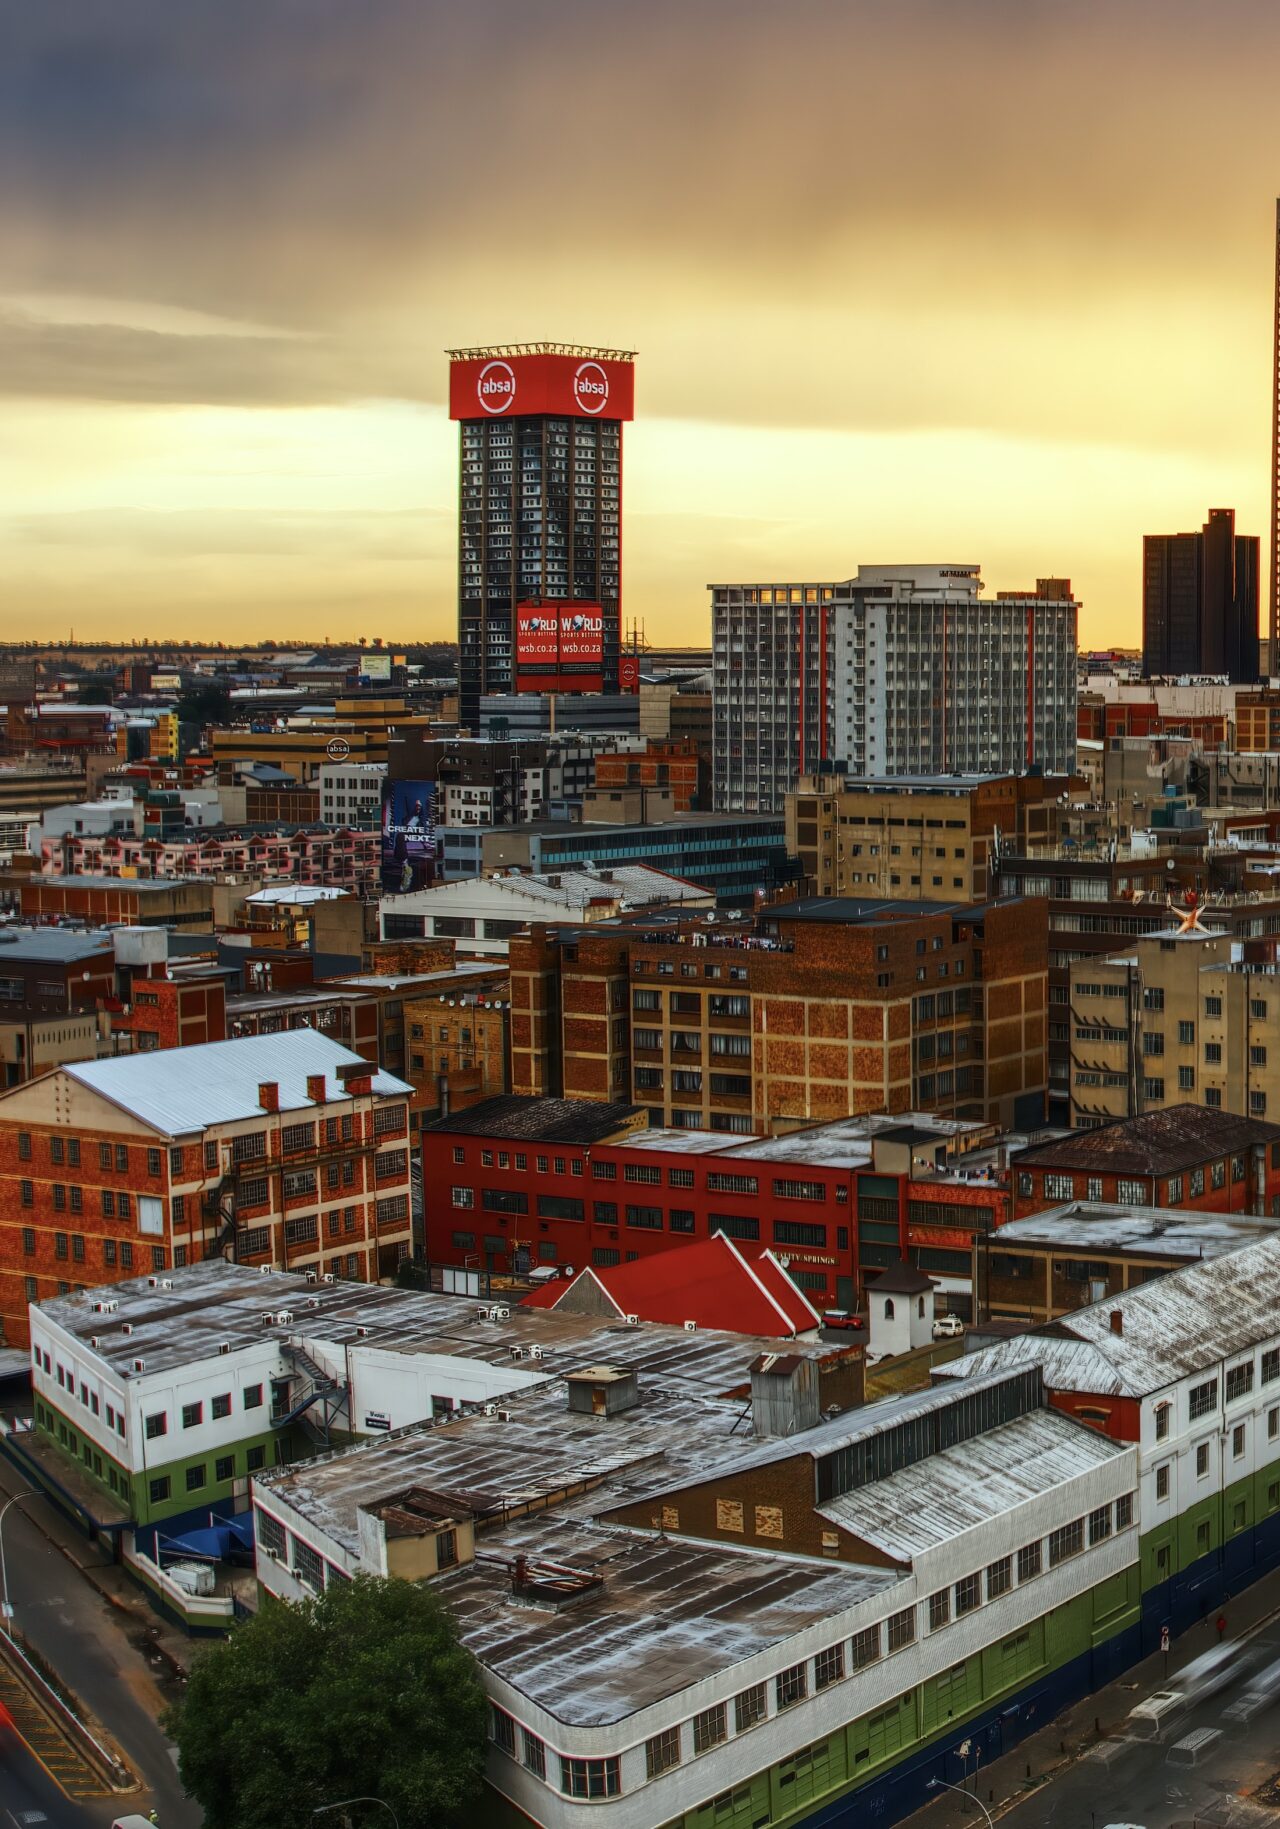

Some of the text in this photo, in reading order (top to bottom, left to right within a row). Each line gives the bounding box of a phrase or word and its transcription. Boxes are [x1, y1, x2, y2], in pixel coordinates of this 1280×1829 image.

[482, 377, 511, 394] absa
[578, 377, 605, 395] absa
[519, 617, 558, 632] WORLD
[561, 614, 602, 632] WORLD
[519, 642, 557, 653] wsb.co.za
[562, 642, 601, 653] wsb.co.za
[329, 744, 347, 752] absa
[387, 825, 425, 833] CREATE
[404, 834, 431, 842] NEXT
[803, 1253, 836, 1265] SPRINGS
